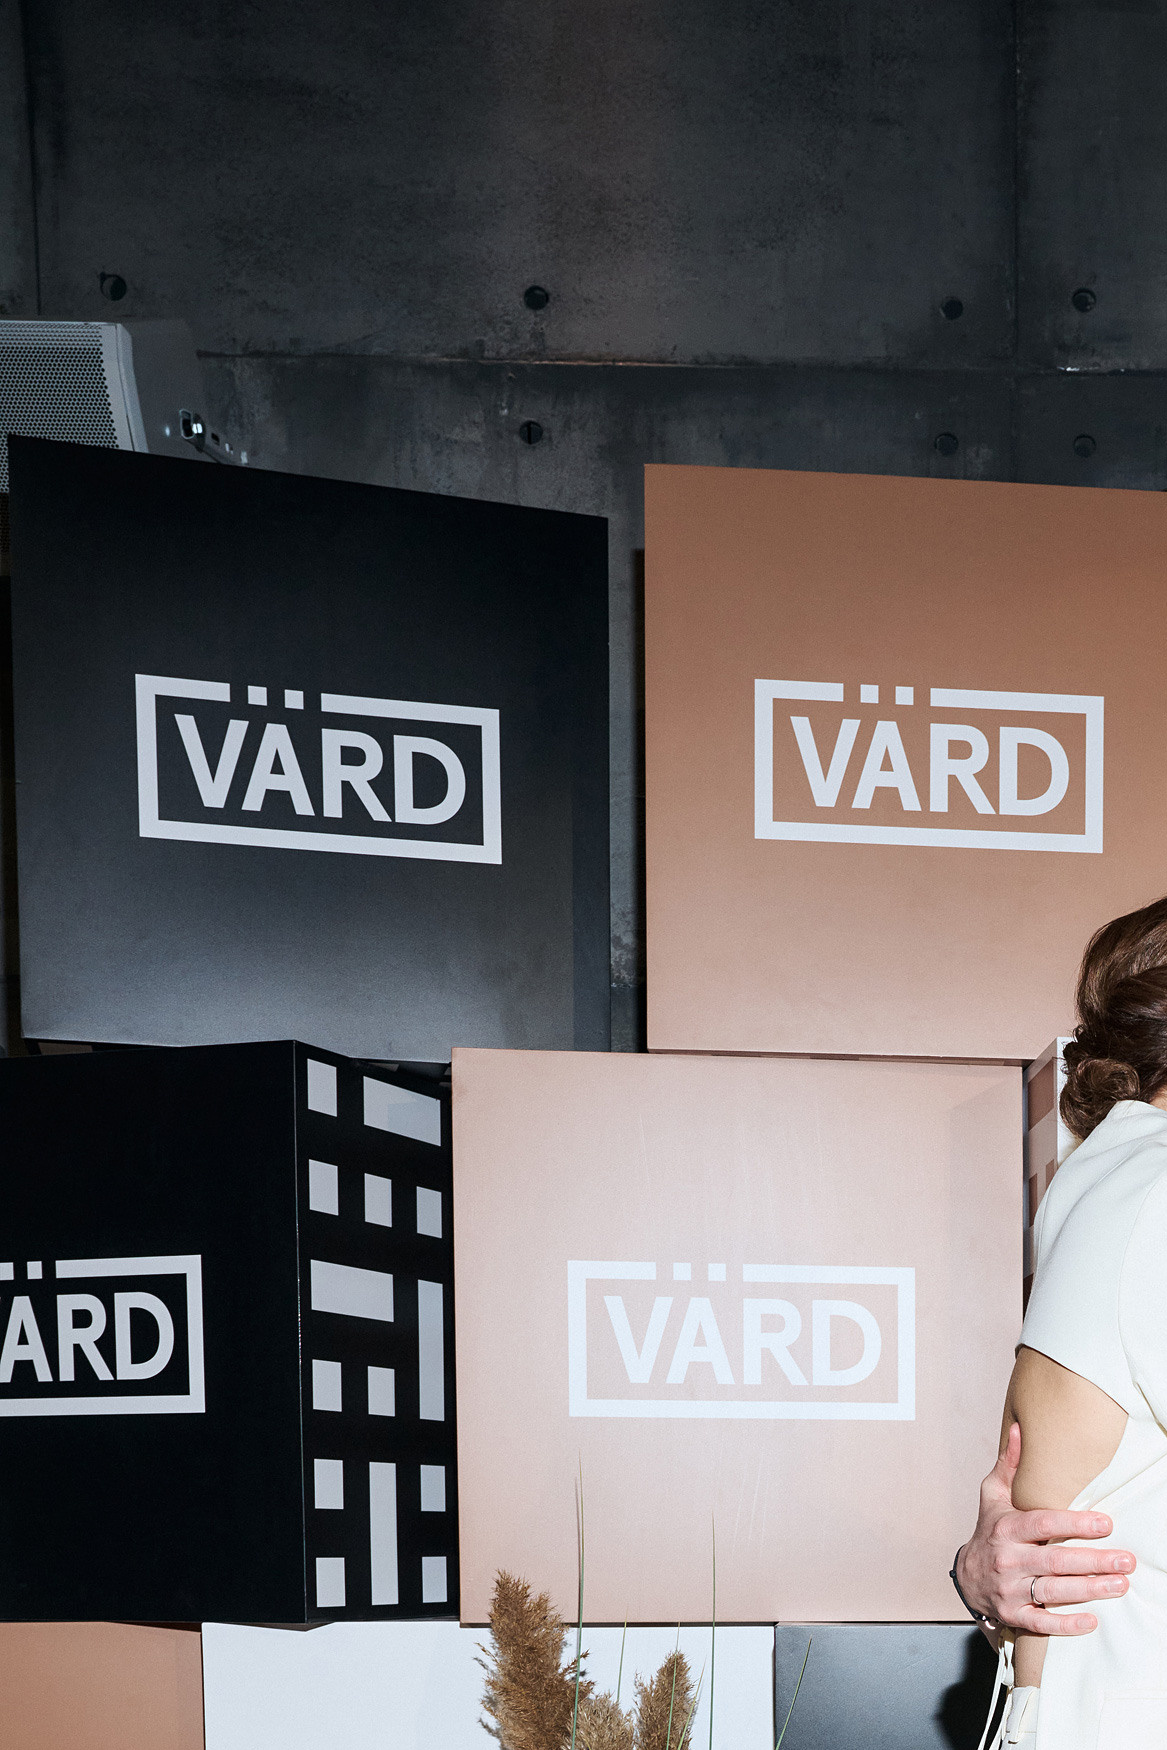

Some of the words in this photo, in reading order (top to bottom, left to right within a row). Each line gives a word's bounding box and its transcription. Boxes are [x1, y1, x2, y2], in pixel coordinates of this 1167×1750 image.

[175, 686, 465, 824] VÄRD
[790, 685, 1069, 816] VÄRD
[0, 1261, 174, 1383] ÄRD
[604, 1263, 881, 1386] VÄRD
